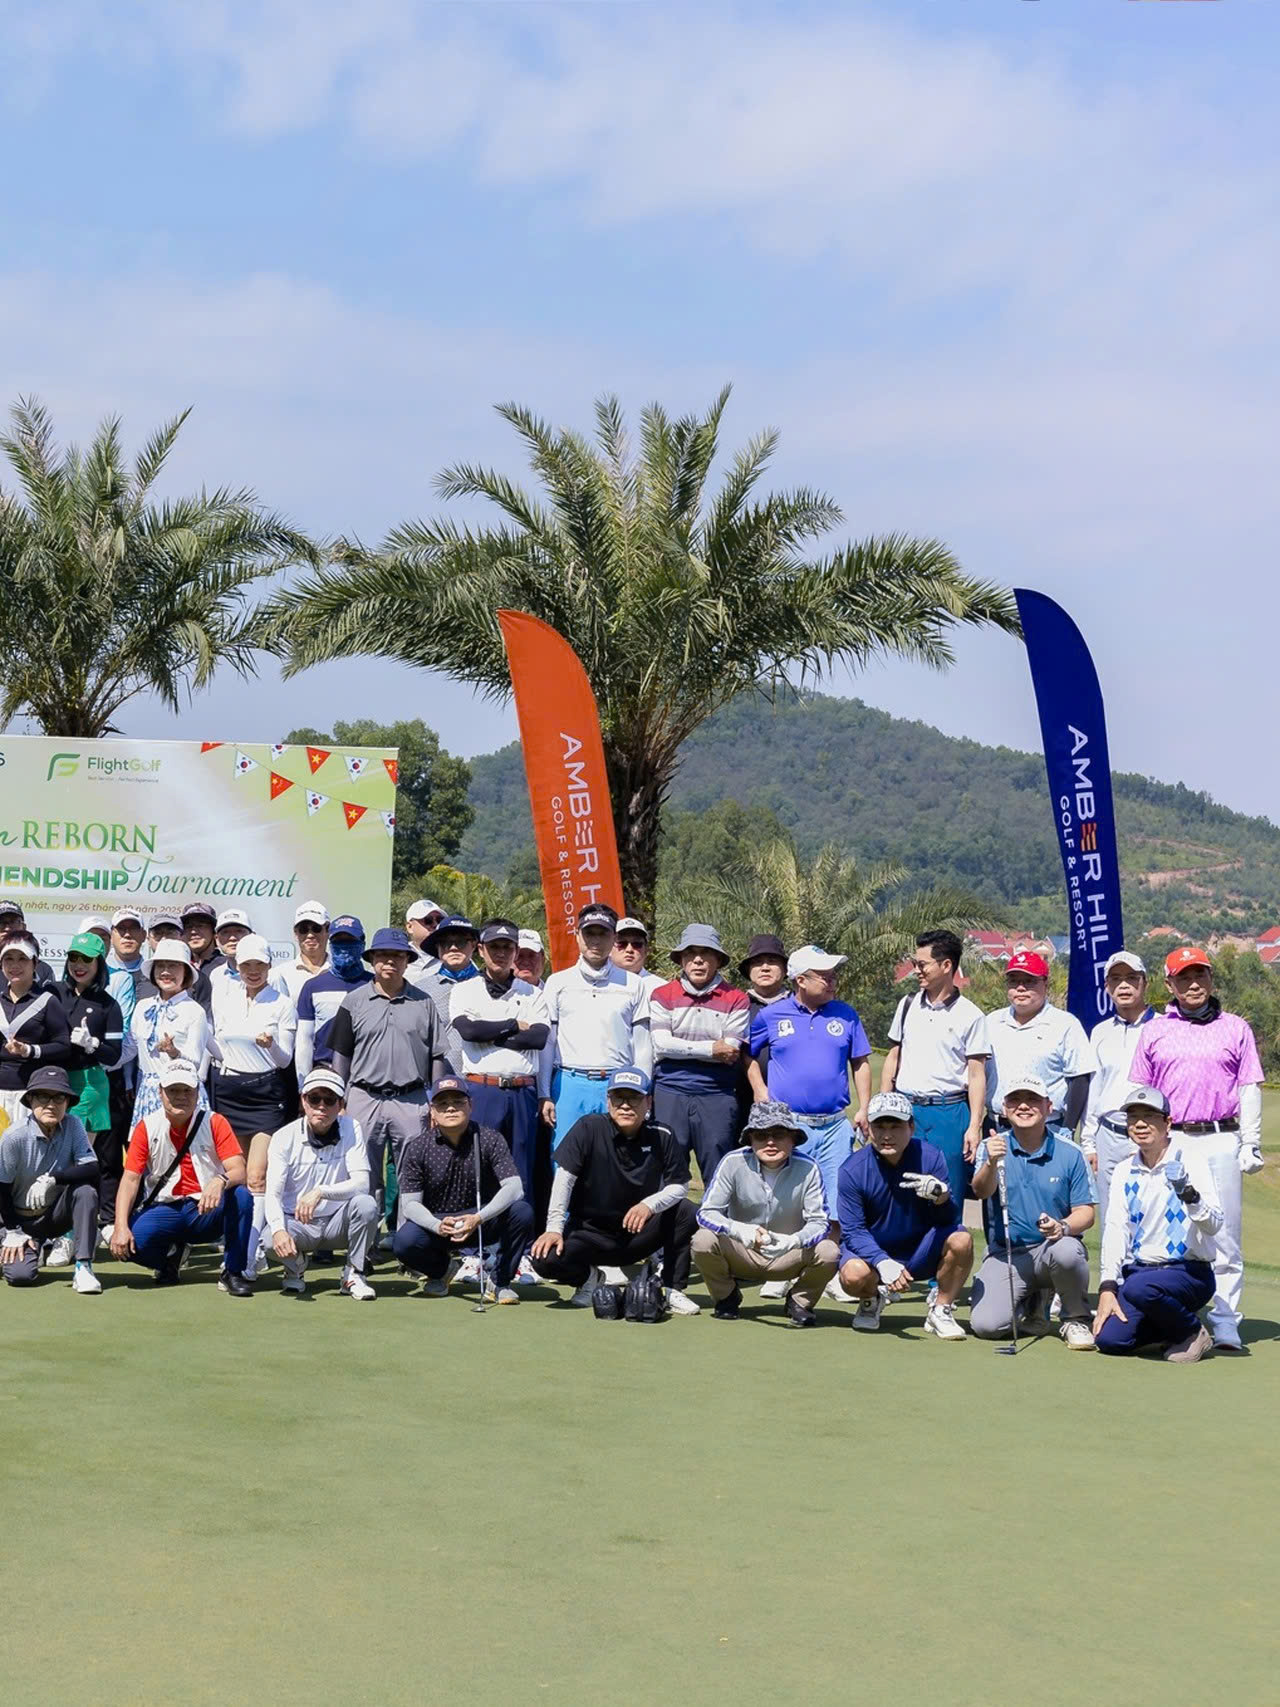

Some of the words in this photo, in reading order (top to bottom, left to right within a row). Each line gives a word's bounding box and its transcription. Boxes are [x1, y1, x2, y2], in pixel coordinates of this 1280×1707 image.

[87, 756, 161, 775] FlightGolf
[551, 796, 567, 845] GOLF
[560, 731, 600, 874] AMBER
[1060, 795, 1075, 849] GOLF
[1067, 724, 1102, 882] AMBER
[21, 819, 158, 855] REBORN
[558, 851, 569, 863] &
[120, 853, 299, 899] Tournament
[1067, 856, 1077, 870] &
[78, 903, 90, 911] 26
[560, 868, 577, 937] RESORT
[1070, 875, 1087, 952] RESORT
[616, 1073, 639, 1084] PING
